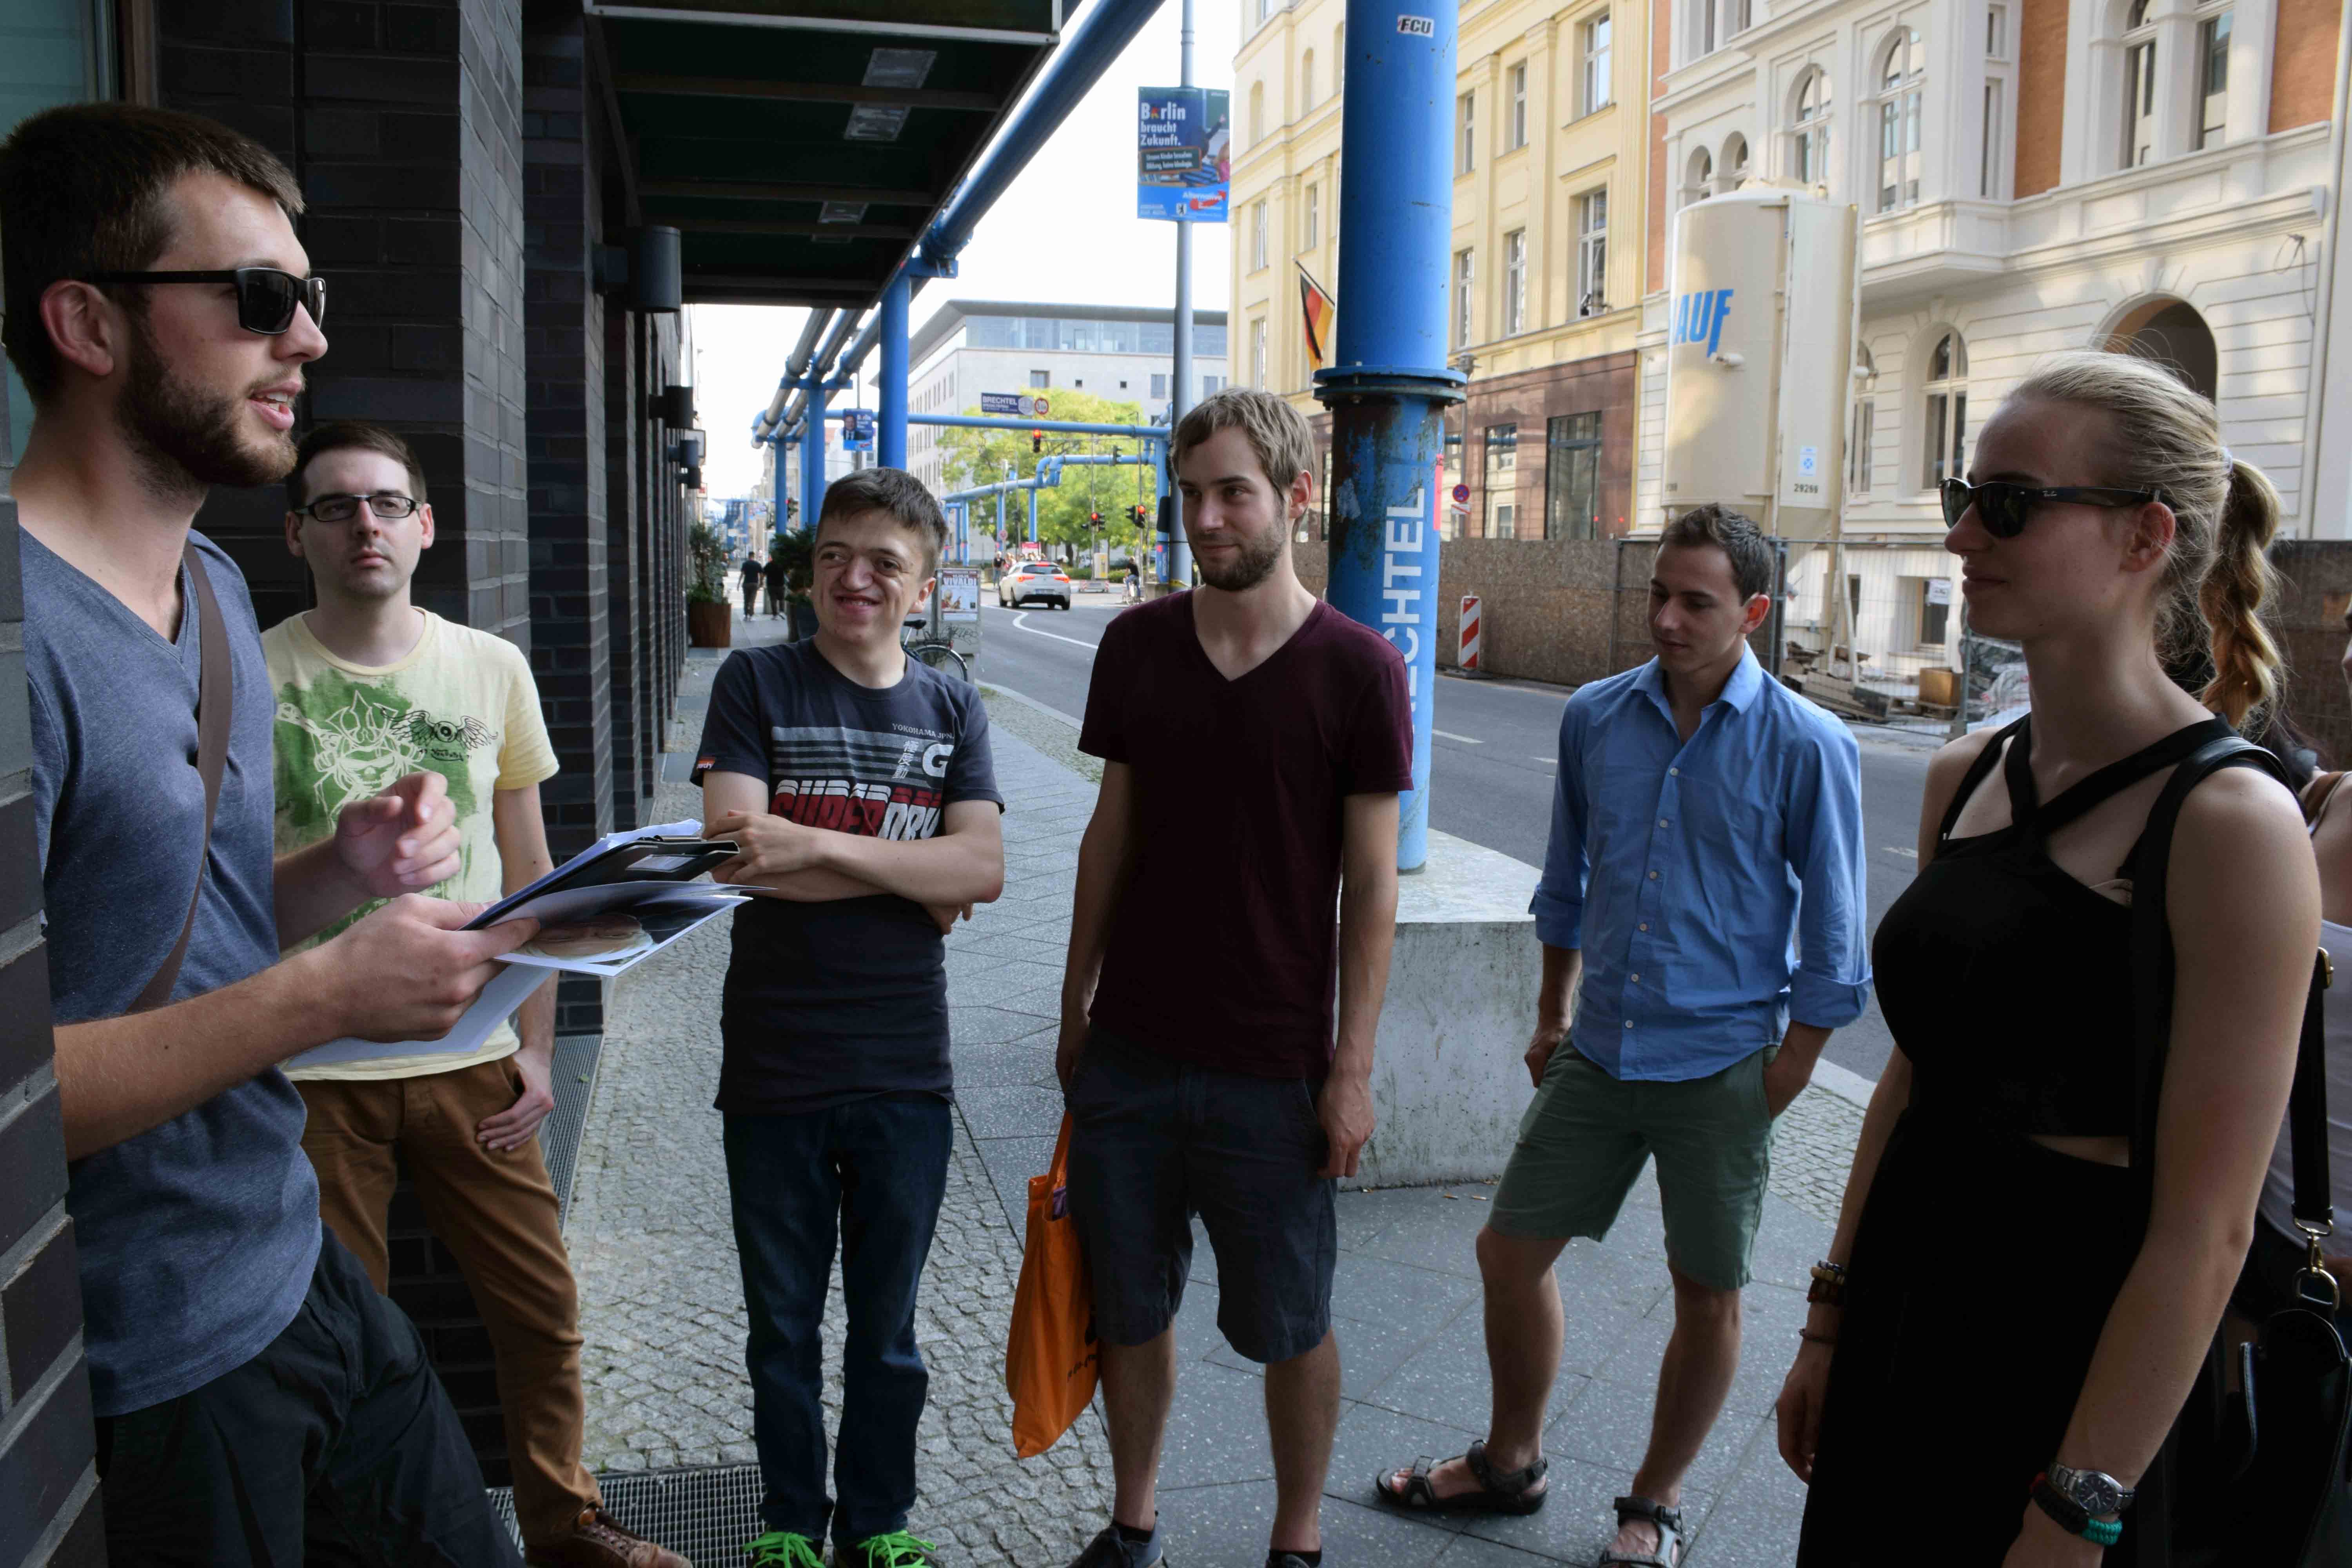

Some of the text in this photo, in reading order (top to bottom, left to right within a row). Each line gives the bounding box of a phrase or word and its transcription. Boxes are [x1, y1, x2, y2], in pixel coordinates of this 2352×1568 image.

[1401, 18, 1431, 33] FCU
[1141, 121, 1176, 133] braucht
[1140, 134, 1181, 146] Zukunft.
[1675, 289, 1734, 358] AUF
[983, 396, 1017, 405] BRECHTEL
[943, 576, 977, 586] VIVALDI
[892, 723, 936, 737] YOKOHAMA
